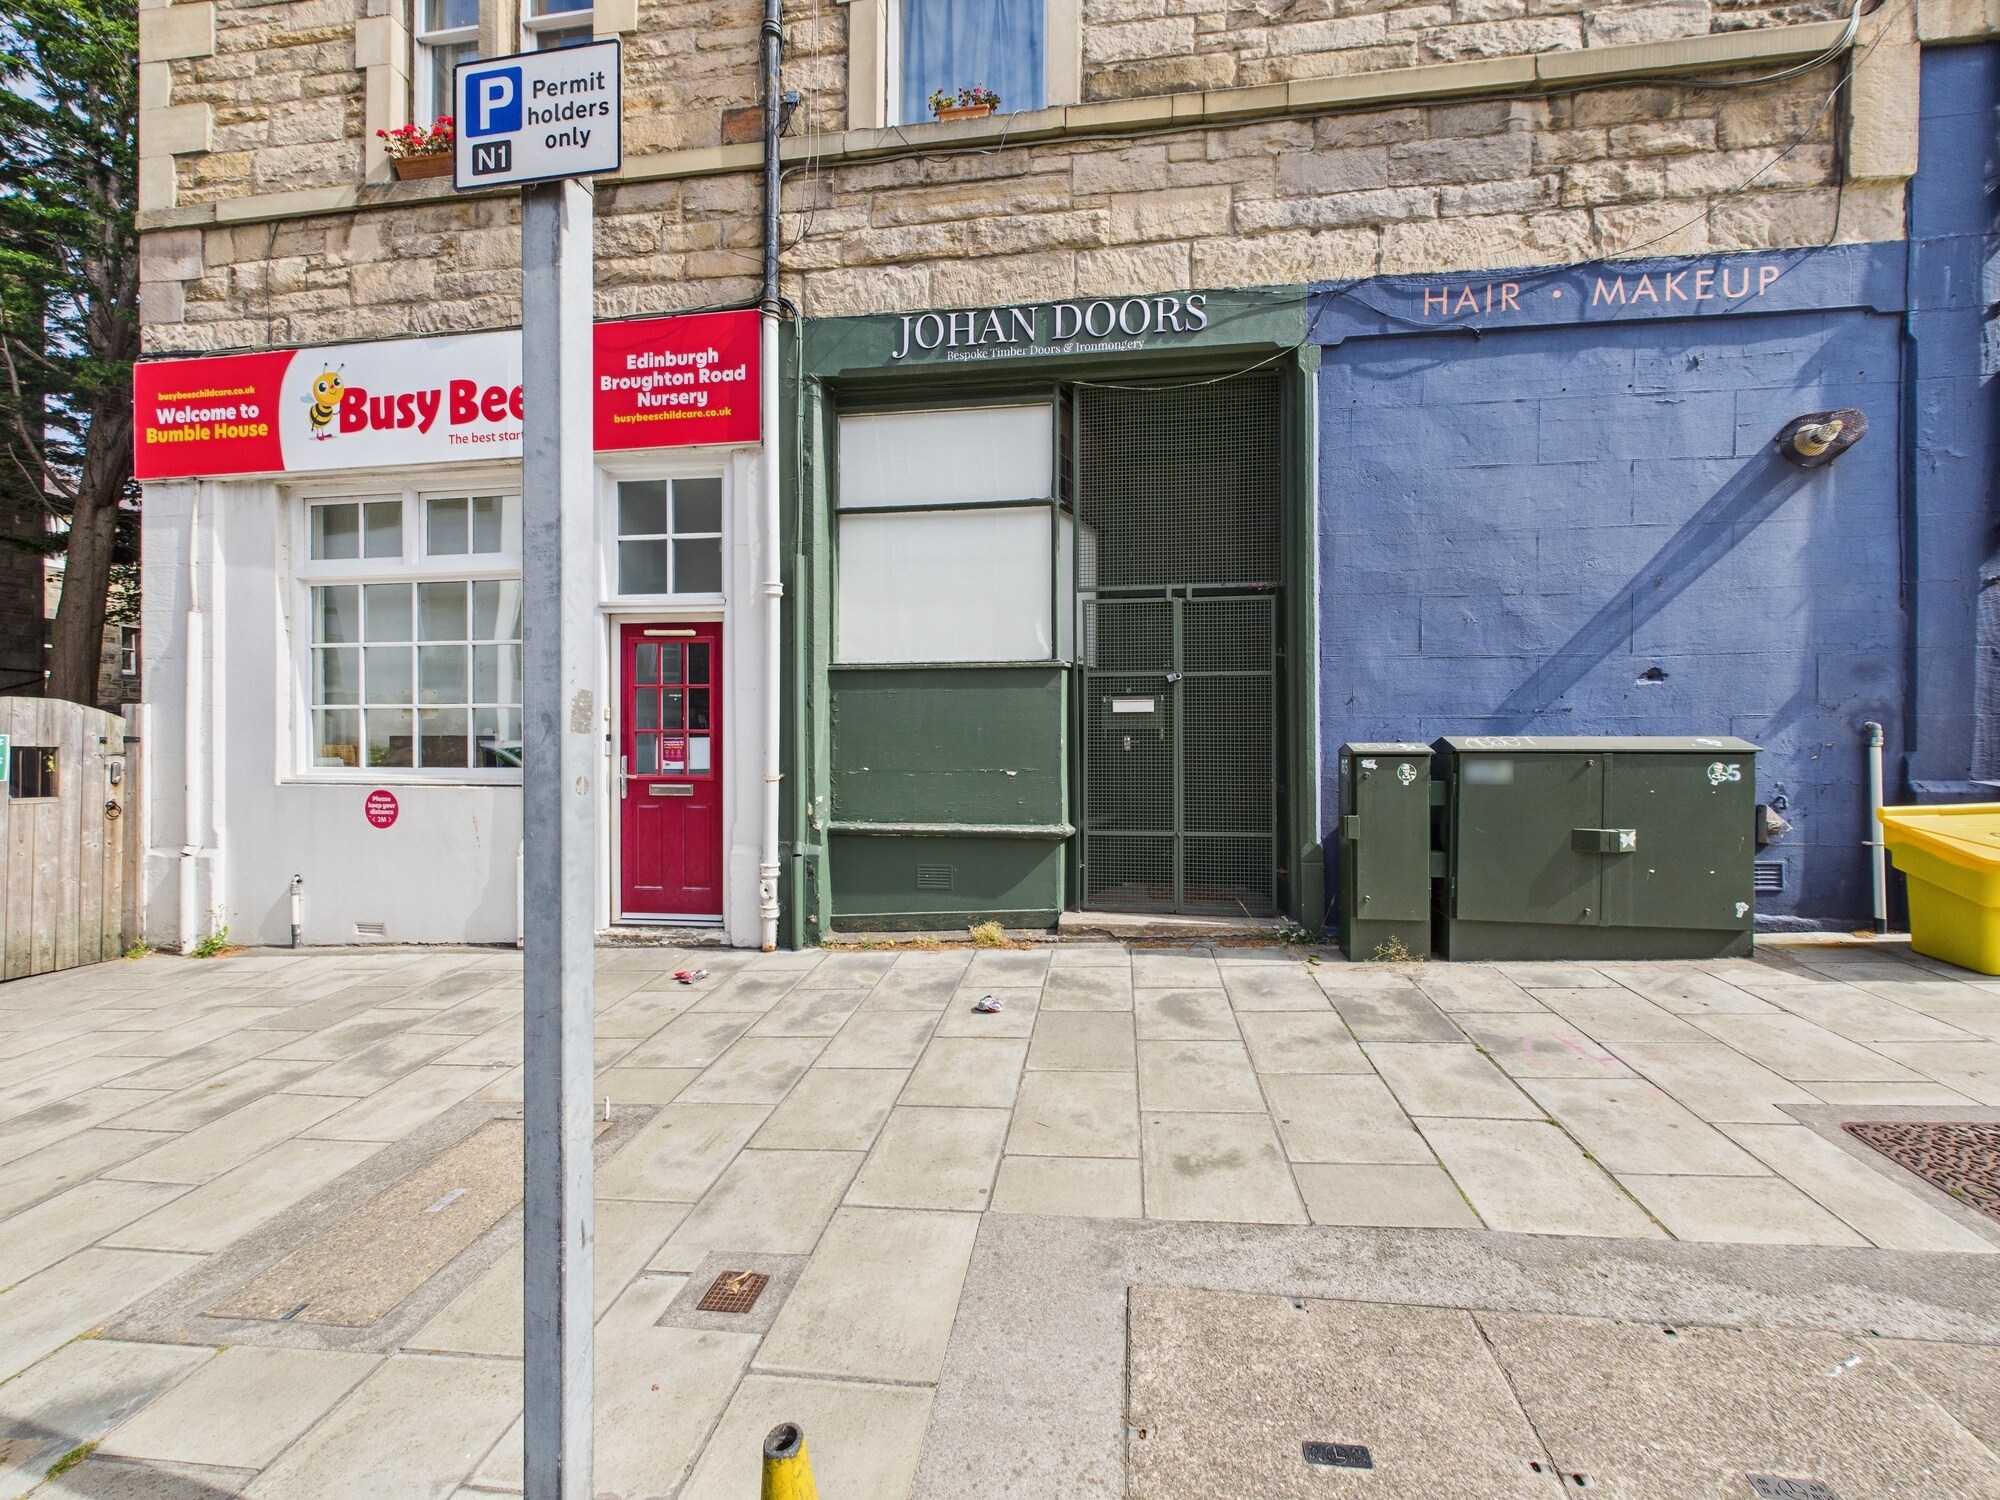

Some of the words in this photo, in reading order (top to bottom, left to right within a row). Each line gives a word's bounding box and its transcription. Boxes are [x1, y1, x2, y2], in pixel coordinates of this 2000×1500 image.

[533, 71, 605, 98] Permit
[479, 76, 514, 130] P
[528, 100, 610, 125] holders
[546, 127, 591, 148] only
[478, 145, 506, 171] N1
[1424, 283, 1521, 316] HAIR
[1592, 266, 1780, 306] MAKEUP
[892, 307, 1038, 360] JOHAN
[1052, 294, 1208, 341] DOORS
[627, 348, 718, 369] Edinburgh
[947, 348, 988, 361] Bespoke
[990, 346, 1027, 357] Timber
[1030, 344, 1060, 355] Doors
[1063, 342, 1074, 353] &
[1076, 338, 1145, 352] Ironmongery
[601, 371, 694, 391] Broughton
[698, 364, 746, 384] Road
[158, 384, 256, 401] busybeeschildcare.co.uk
[638, 392, 708, 407] Nursery
[156, 405, 236, 425] Welcome
[239, 404, 259, 419] to
[340, 387, 441, 434] Busy
[450, 379, 524, 425] Bee
[614, 408, 731, 423] busybeeschildcare.co.uk
[146, 423, 210, 444] Bumble
[214, 422, 268, 440] House
[448, 434, 468, 444] The
[472, 432, 496, 442] best
